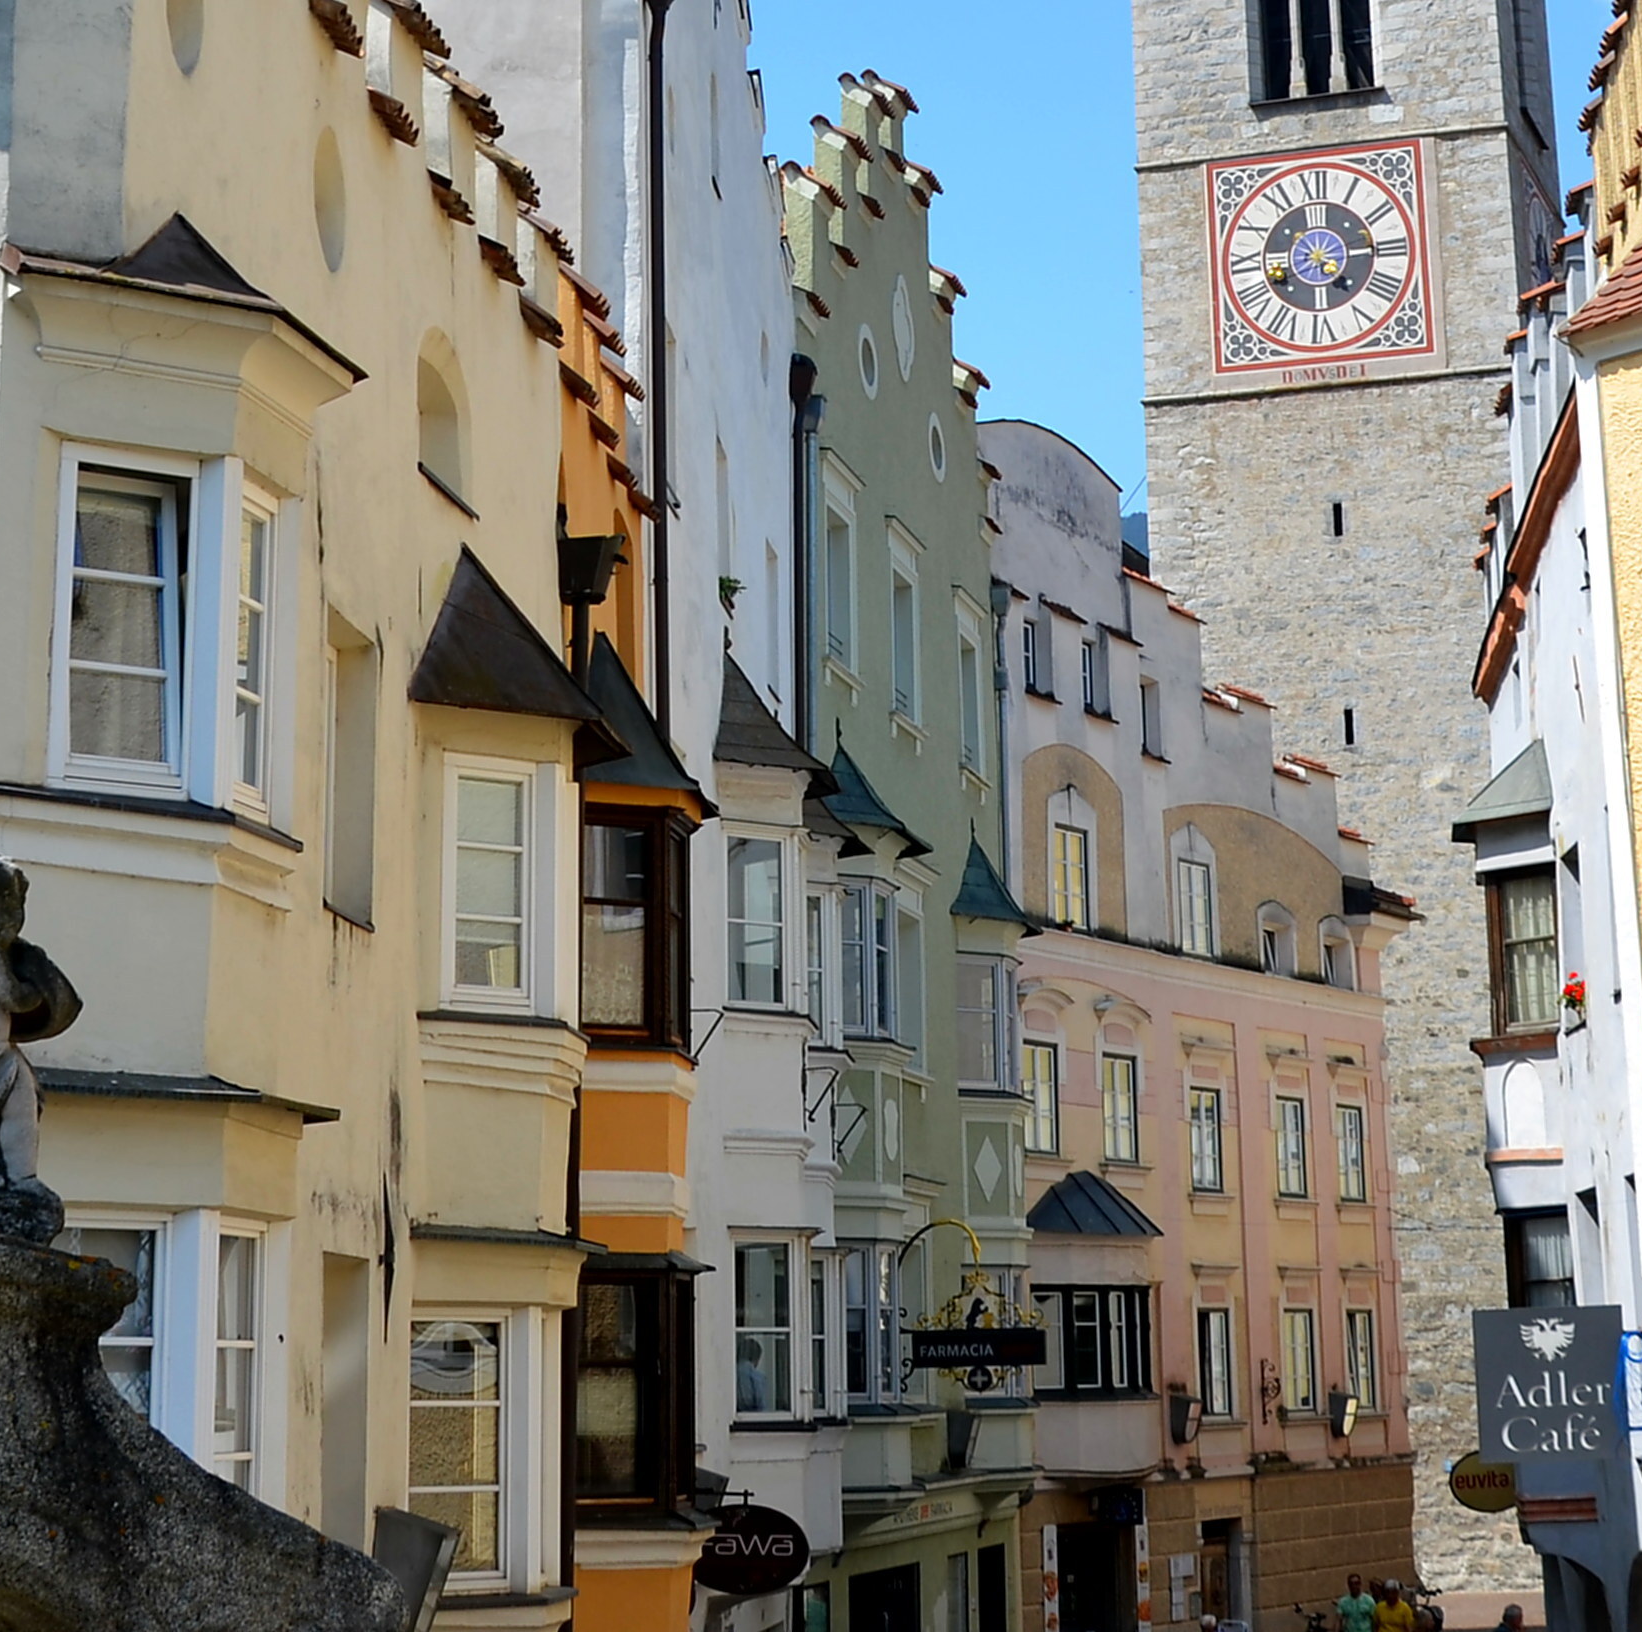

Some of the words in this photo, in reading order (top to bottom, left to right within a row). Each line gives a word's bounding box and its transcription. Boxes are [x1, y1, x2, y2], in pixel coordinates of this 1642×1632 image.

[919, 1344, 994, 1357] FARMACIA
[1496, 1371, 1612, 1408] Adler
[1501, 1413, 1601, 1452] Café
[1455, 1470, 1509, 1490] euvita
